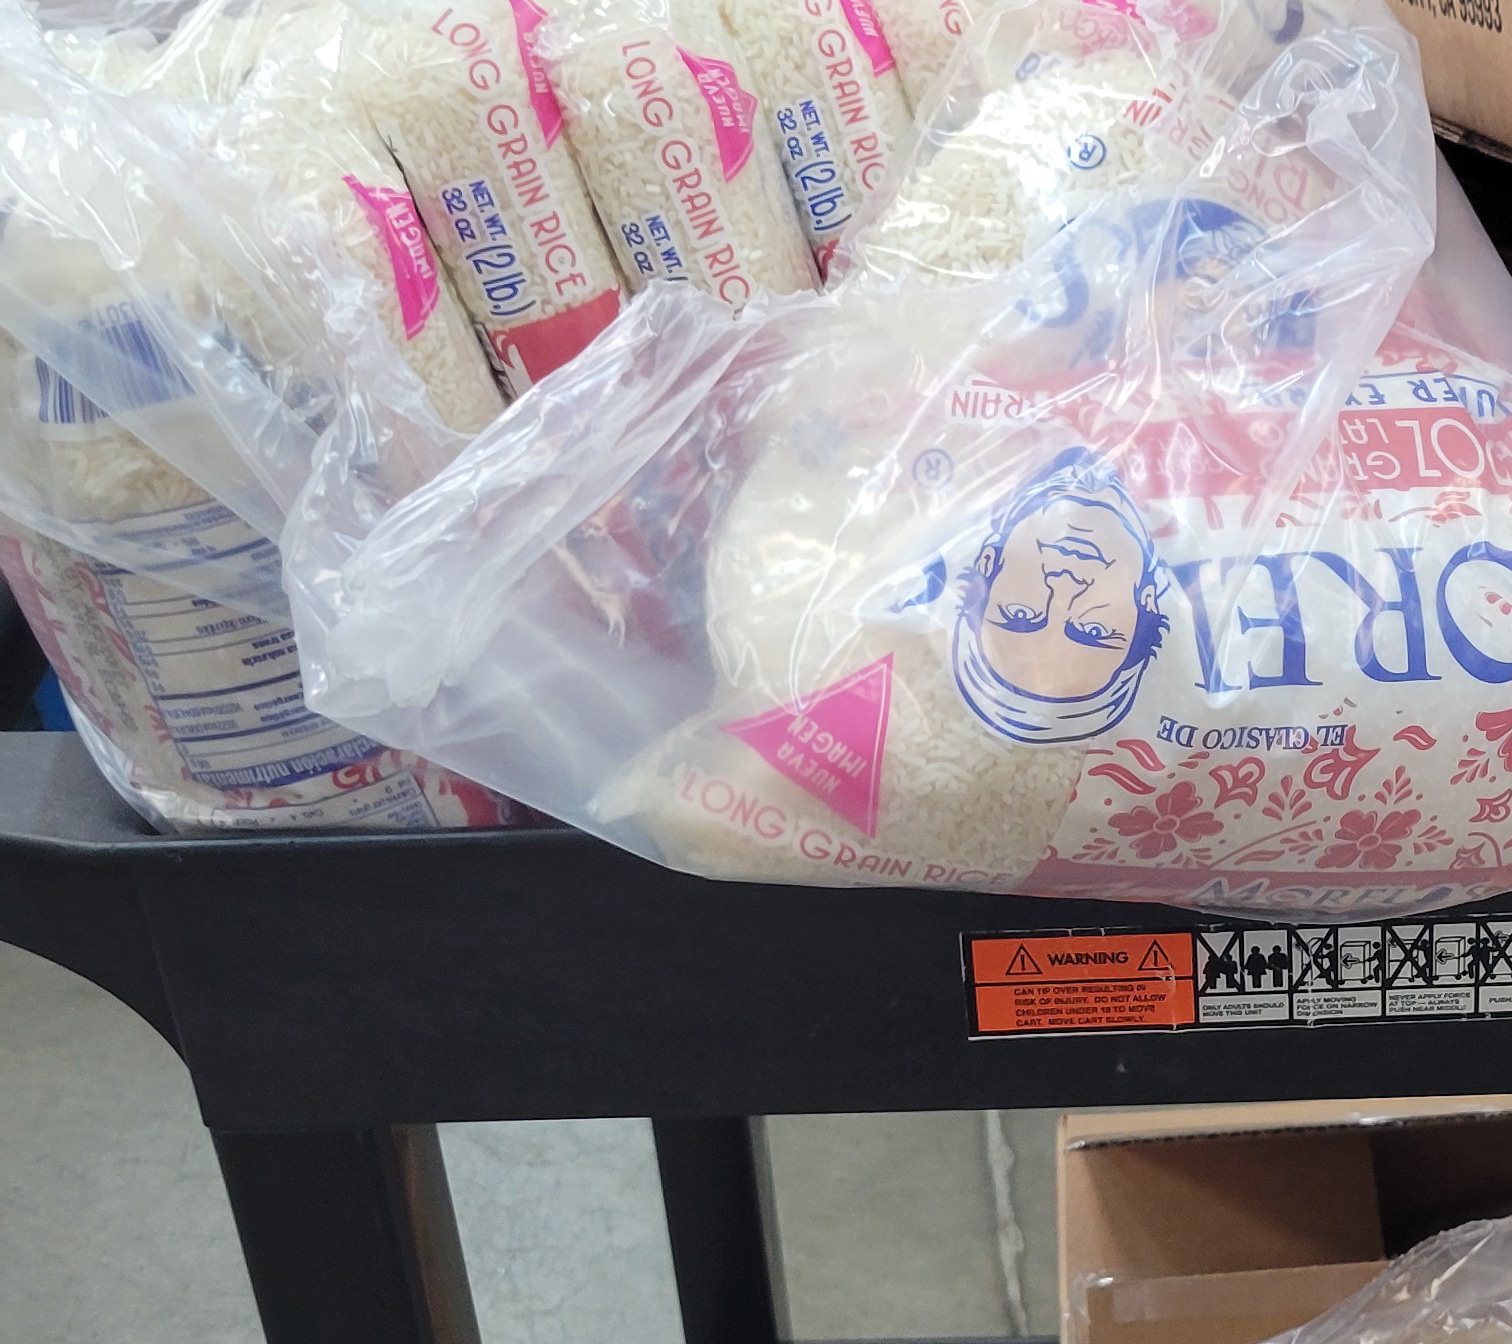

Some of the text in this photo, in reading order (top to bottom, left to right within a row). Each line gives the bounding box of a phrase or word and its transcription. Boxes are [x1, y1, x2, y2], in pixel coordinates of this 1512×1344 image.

[816, 28, 870, 126] GRAIN
[777, 107, 796, 135] 32
[431, 7, 588, 299] LONG GRAIN RICE
[621, 40, 752, 321] LONG GRAIN RIC
[440, 186, 469, 217] 32
[469, 178, 510, 242] NET. WT.
[619, 220, 646, 254] 32
[644, 213, 685, 274] NET. WT.
[786, 714, 868, 780] IMAGEN
[1158, 716, 1348, 752] EL CLASICO DE
[777, 742, 841, 794] NUEVA
[680, 768, 789, 841] LONG
[798, 828, 914, 879] GRAIN
[1047, 950, 1130, 967] WARNING
[1014, 987, 1036, 997] CAN
[1036, 986, 1051, 996] TIP
[1052, 985, 1080, 996] OVER
[1014, 996, 1037, 1006] RISK
[1038, 996, 1053, 1005] OF
[1093, 995, 1109, 1004] DO
[1109, 994, 1132, 1004] NOT
[1132, 993, 1167, 1003] ALLOW
[1223, 1002, 1252, 1010] ADULTS
[1253, 1000, 1285, 1009] SHOULD
[1322, 994, 1357, 1003] MOVING
[1340, 1000, 1378, 1009] NARROW
[1388, 993, 1416, 1002] NEVER
[1443, 991, 1471, 1000] FORCE
[1428, 997, 1460, 1006] ALWAYS
[1014, 1006, 1063, 1017] CHILDREN
[1065, 1006, 1099, 1016] UNDER
[1112, 1005, 1127, 1014] TO
[1127, 1003, 1156, 1014] MOVE
[1047, 1016, 1076, 1026] MOVE
[1077, 1015, 1104, 1025] CART
[1388, 1005, 1410, 1013] PUSH
